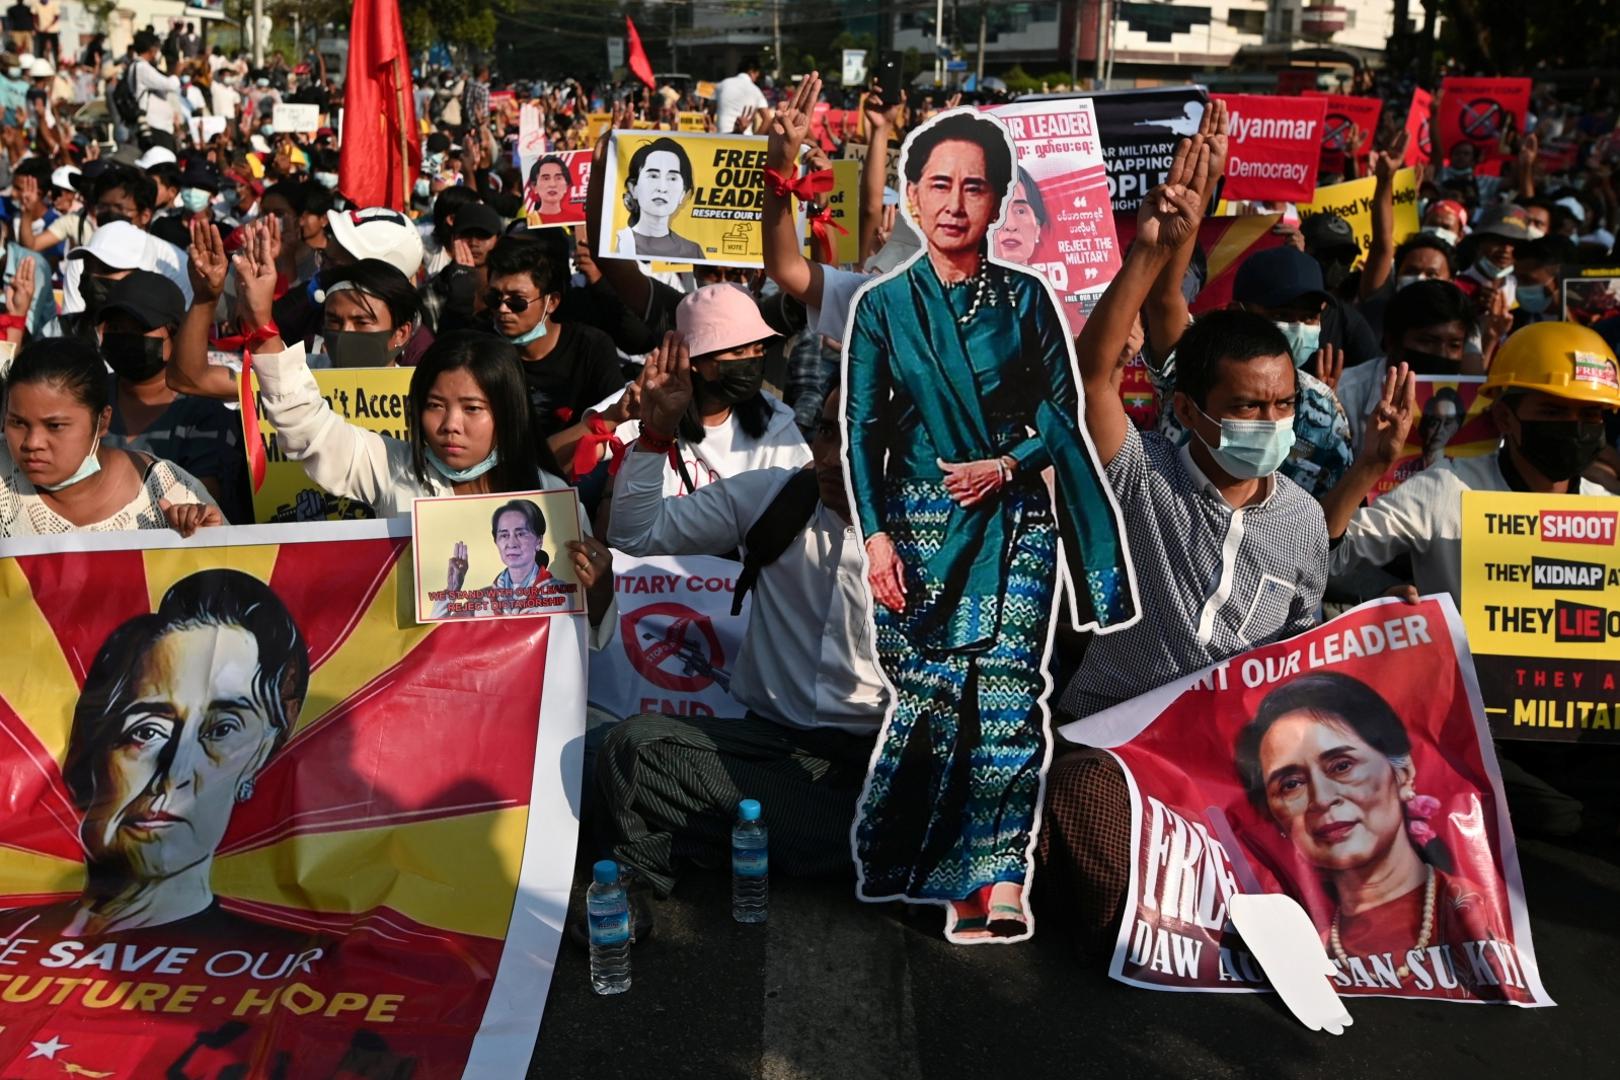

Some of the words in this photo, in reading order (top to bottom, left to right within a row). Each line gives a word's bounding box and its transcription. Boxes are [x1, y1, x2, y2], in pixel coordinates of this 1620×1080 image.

[1001, 117, 1026, 139] UR
[1030, 113, 1091, 137] LEADER
[1226, 111, 1316, 143] Myanmar
[1101, 147, 1115, 157] AR
[1119, 144, 1175, 156] MILITARY
[1104, 157, 1173, 172] NAPPING
[1229, 157, 1308, 184] Democracy
[692, 209, 731, 218] RESPECT
[734, 211, 755, 220] OUR
[1058, 240, 1092, 253] REJECT
[1095, 238, 1112, 250] THE
[1065, 250, 1109, 265] MILITARY
[1484, 513, 1539, 535] THEY
[1542, 515, 1615, 539] SHOOT
[614, 575, 681, 593] ITARY
[686, 575, 738, 593] COU
[1484, 563, 1531, 583] THEY
[1534, 565, 1604, 586] KIDNAP
[428, 592, 446, 601] WE
[449, 590, 484, 601] STAND
[516, 587, 540, 597] OUR
[448, 601, 489, 612] REJECT
[491, 597, 566, 610] DICTATORSHIP
[1484, 605, 1555, 634] THEY
[1559, 609, 1602, 637] LIE
[1241, 650, 1301, 689] OUR
[1308, 614, 1432, 669] LEADER
[1516, 669, 1585, 689] THEY
[39, 940, 199, 975] SAVE
[204, 948, 323, 980] OUR
[1128, 918, 1204, 980] DAW
[1218, 946, 1267, 983] AU
[1405, 945, 1458, 991] SU
[231, 982, 405, 1022] HOPE
